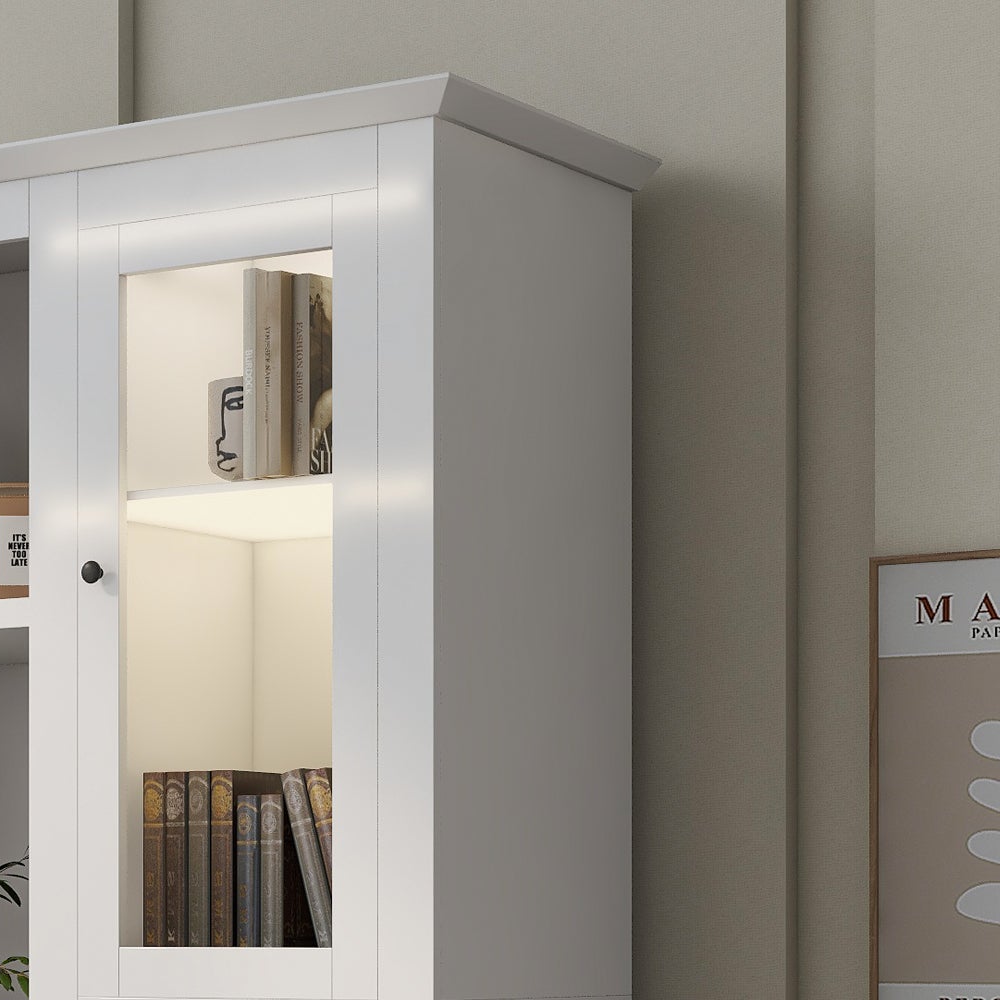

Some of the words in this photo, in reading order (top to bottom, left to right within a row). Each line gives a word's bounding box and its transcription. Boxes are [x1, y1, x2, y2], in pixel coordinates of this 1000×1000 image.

[296, 322, 304, 369] FASHION
[296, 371, 304, 404] SHOW
[12, 534, 27, 542] IT'S
[12, 550, 27, 558] TOO
[11, 559, 28, 567] LATE
